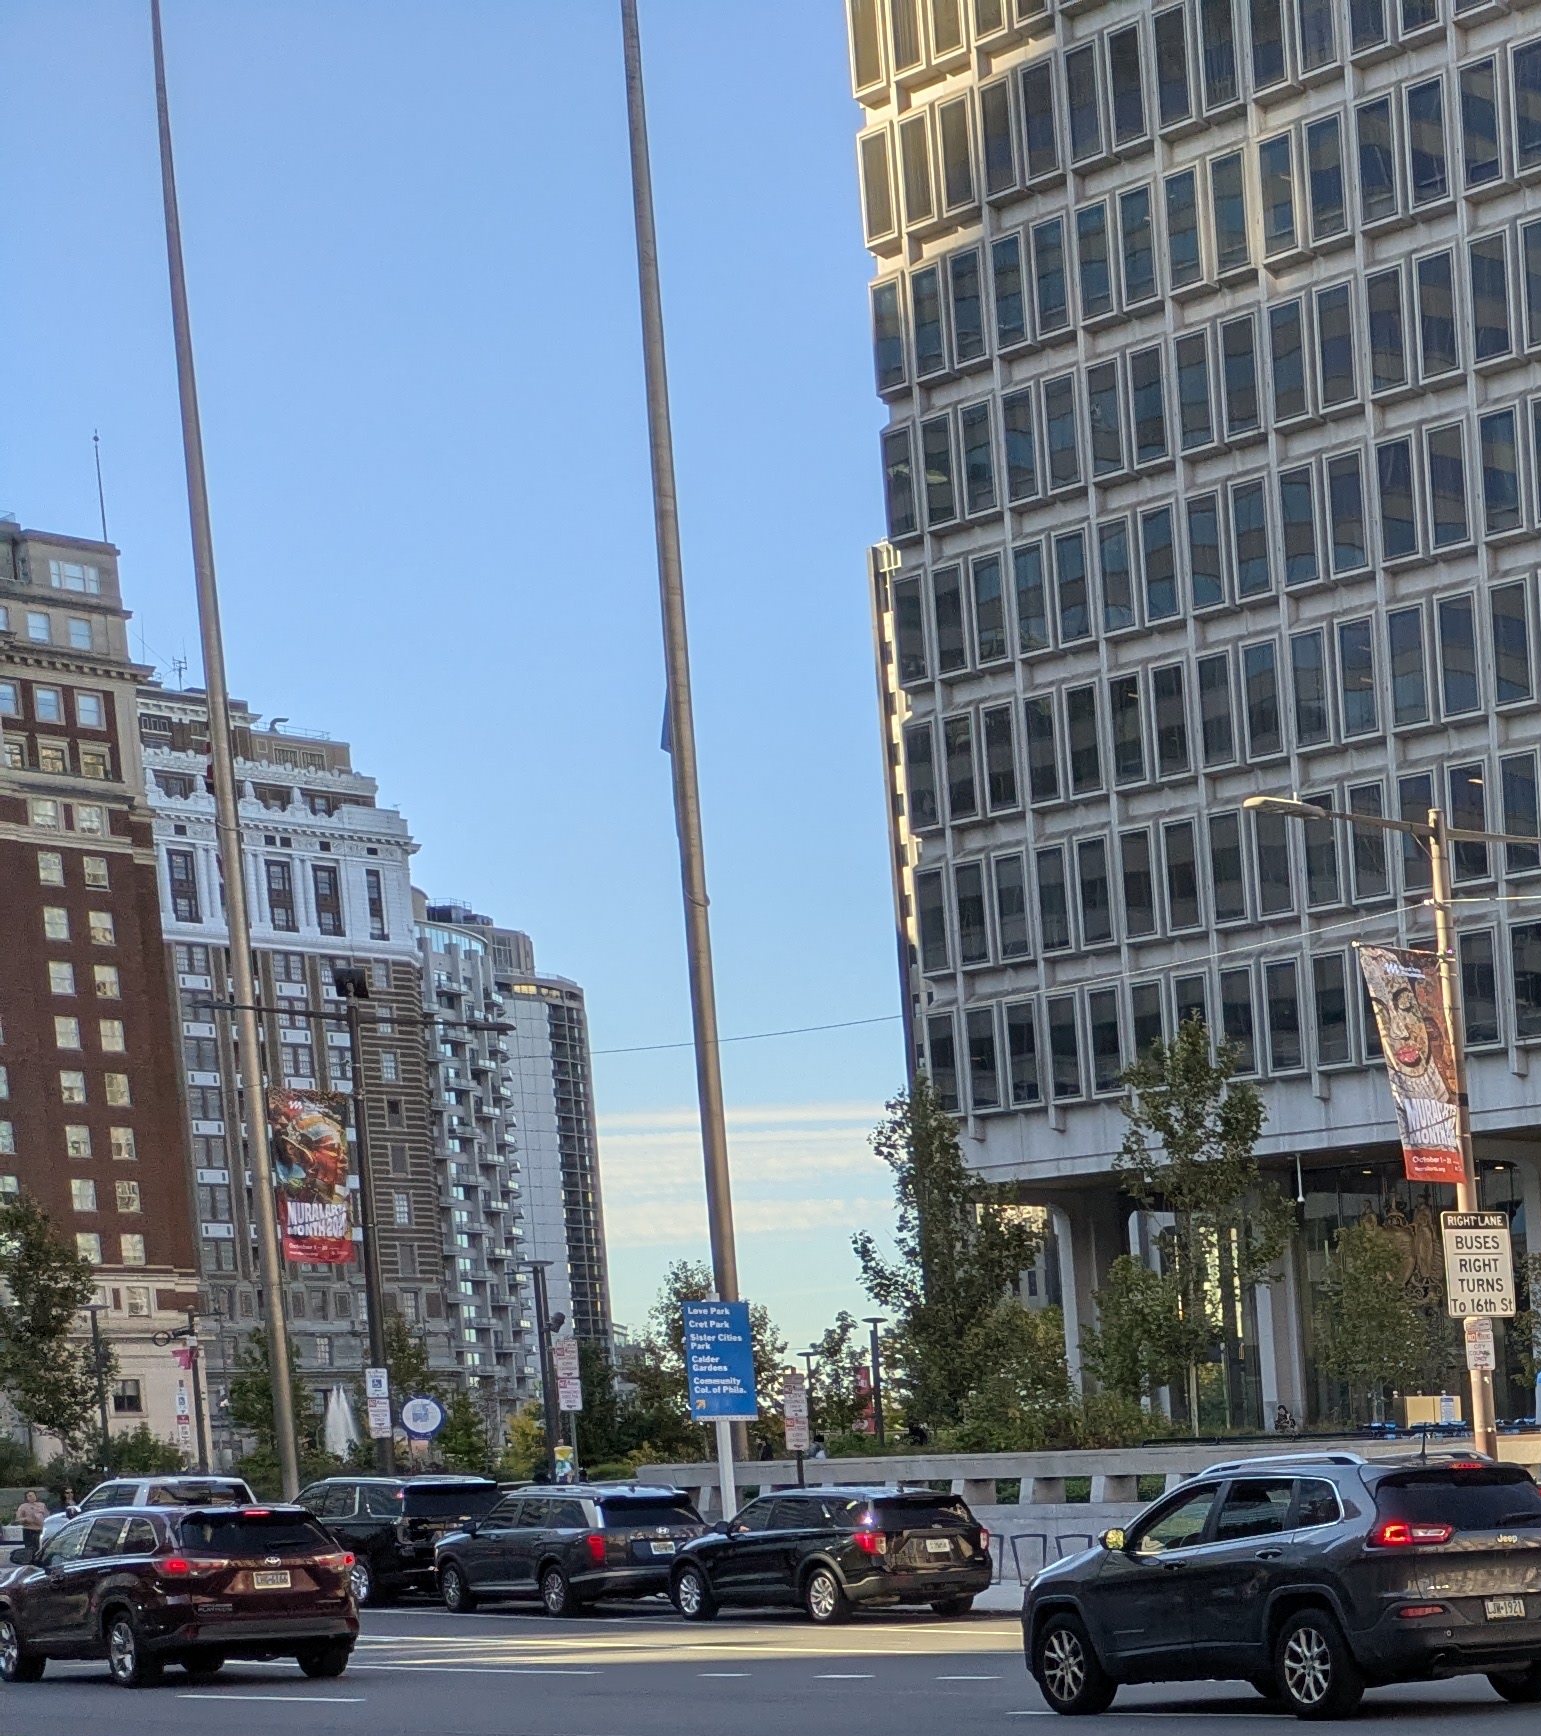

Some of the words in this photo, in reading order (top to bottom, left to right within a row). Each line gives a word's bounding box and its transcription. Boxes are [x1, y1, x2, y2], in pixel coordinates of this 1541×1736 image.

[1412, 1156, 1439, 1164] October
[287, 1201, 325, 1226] MURAL
[1447, 1216, 1476, 1226] RIGHT
[1478, 1216, 1503, 1226] LANE
[288, 1220, 326, 1237] MONTH
[1455, 1236, 1500, 1250] BUSES
[1459, 1258, 1499, 1273] RIGHT
[1458, 1278, 1504, 1293] TURNS
[1451, 1298, 1466, 1313] To
[1470, 1298, 1496, 1312] 16th
[1500, 1298, 1513, 1312] St
[688, 1307, 708, 1315] Love
[710, 1307, 730, 1315] Park
[689, 1320, 708, 1328] Cret
[710, 1320, 729, 1328] Park
[690, 1334, 716, 1342] Sister
[718, 1334, 742, 1342] Cities
[691, 1342, 711, 1350] Park
[692, 1364, 728, 1372] Gardens
[694, 1377, 741, 1386] Community
[712, 1386, 721, 1394] of
[723, 1386, 747, 1394] Phila.
[1497, 1534, 1518, 1543] Jeep
